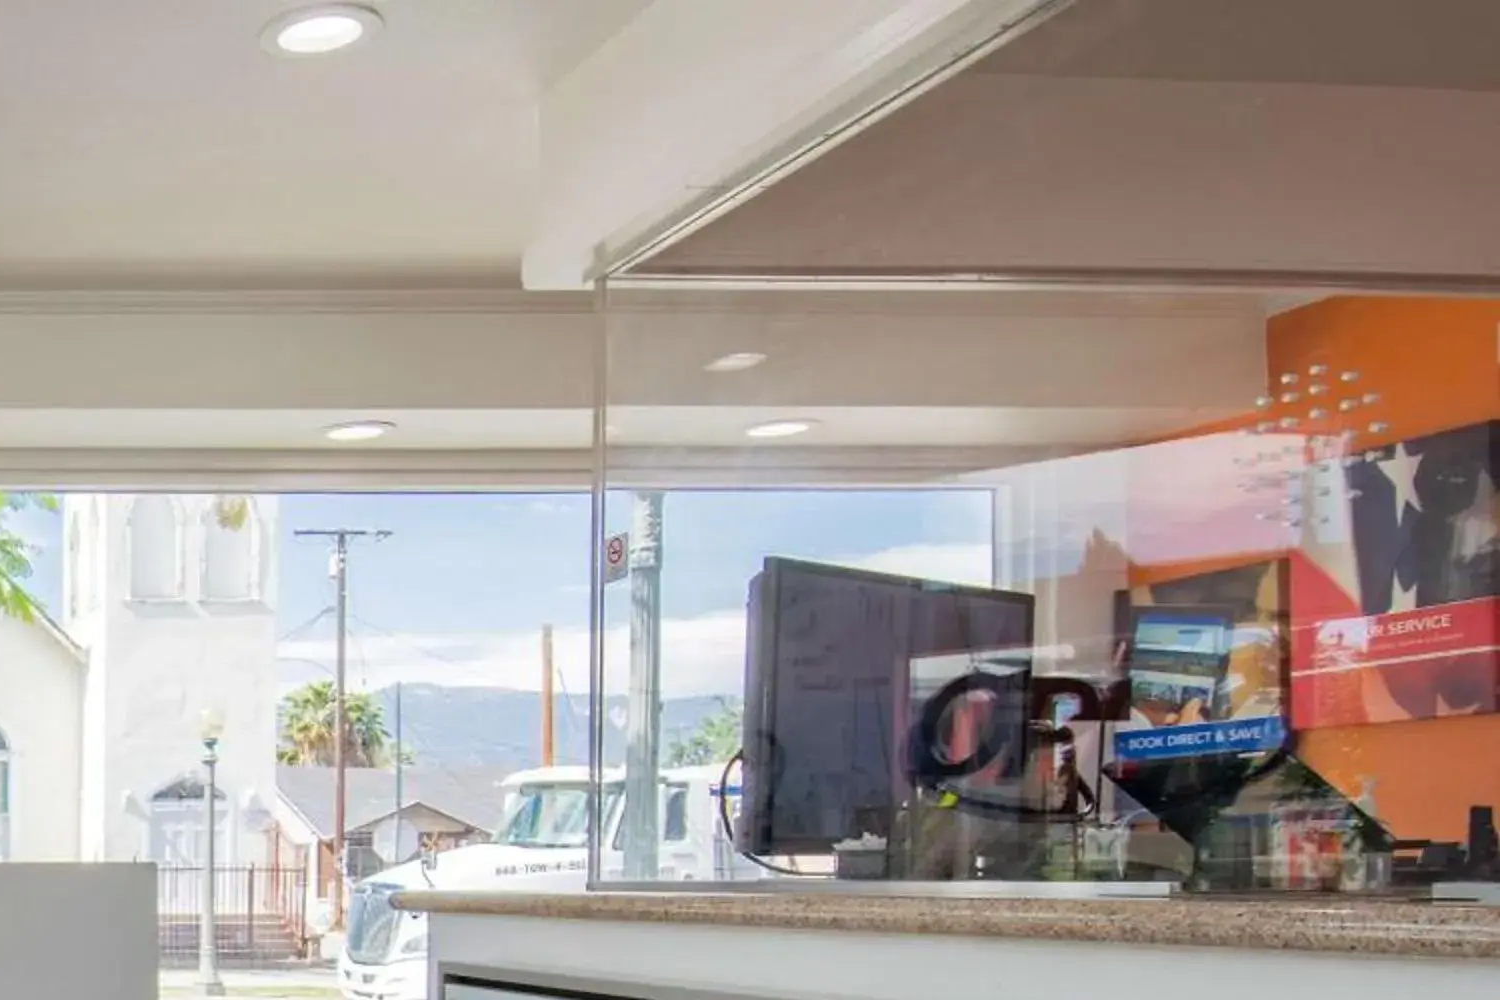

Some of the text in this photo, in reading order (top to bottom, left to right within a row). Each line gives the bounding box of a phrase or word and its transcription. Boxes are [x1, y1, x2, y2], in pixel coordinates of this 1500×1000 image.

[1387, 613, 1452, 635] SERVICE
[1128, 725, 1262, 750] BOOK DIRECT & SAVE
